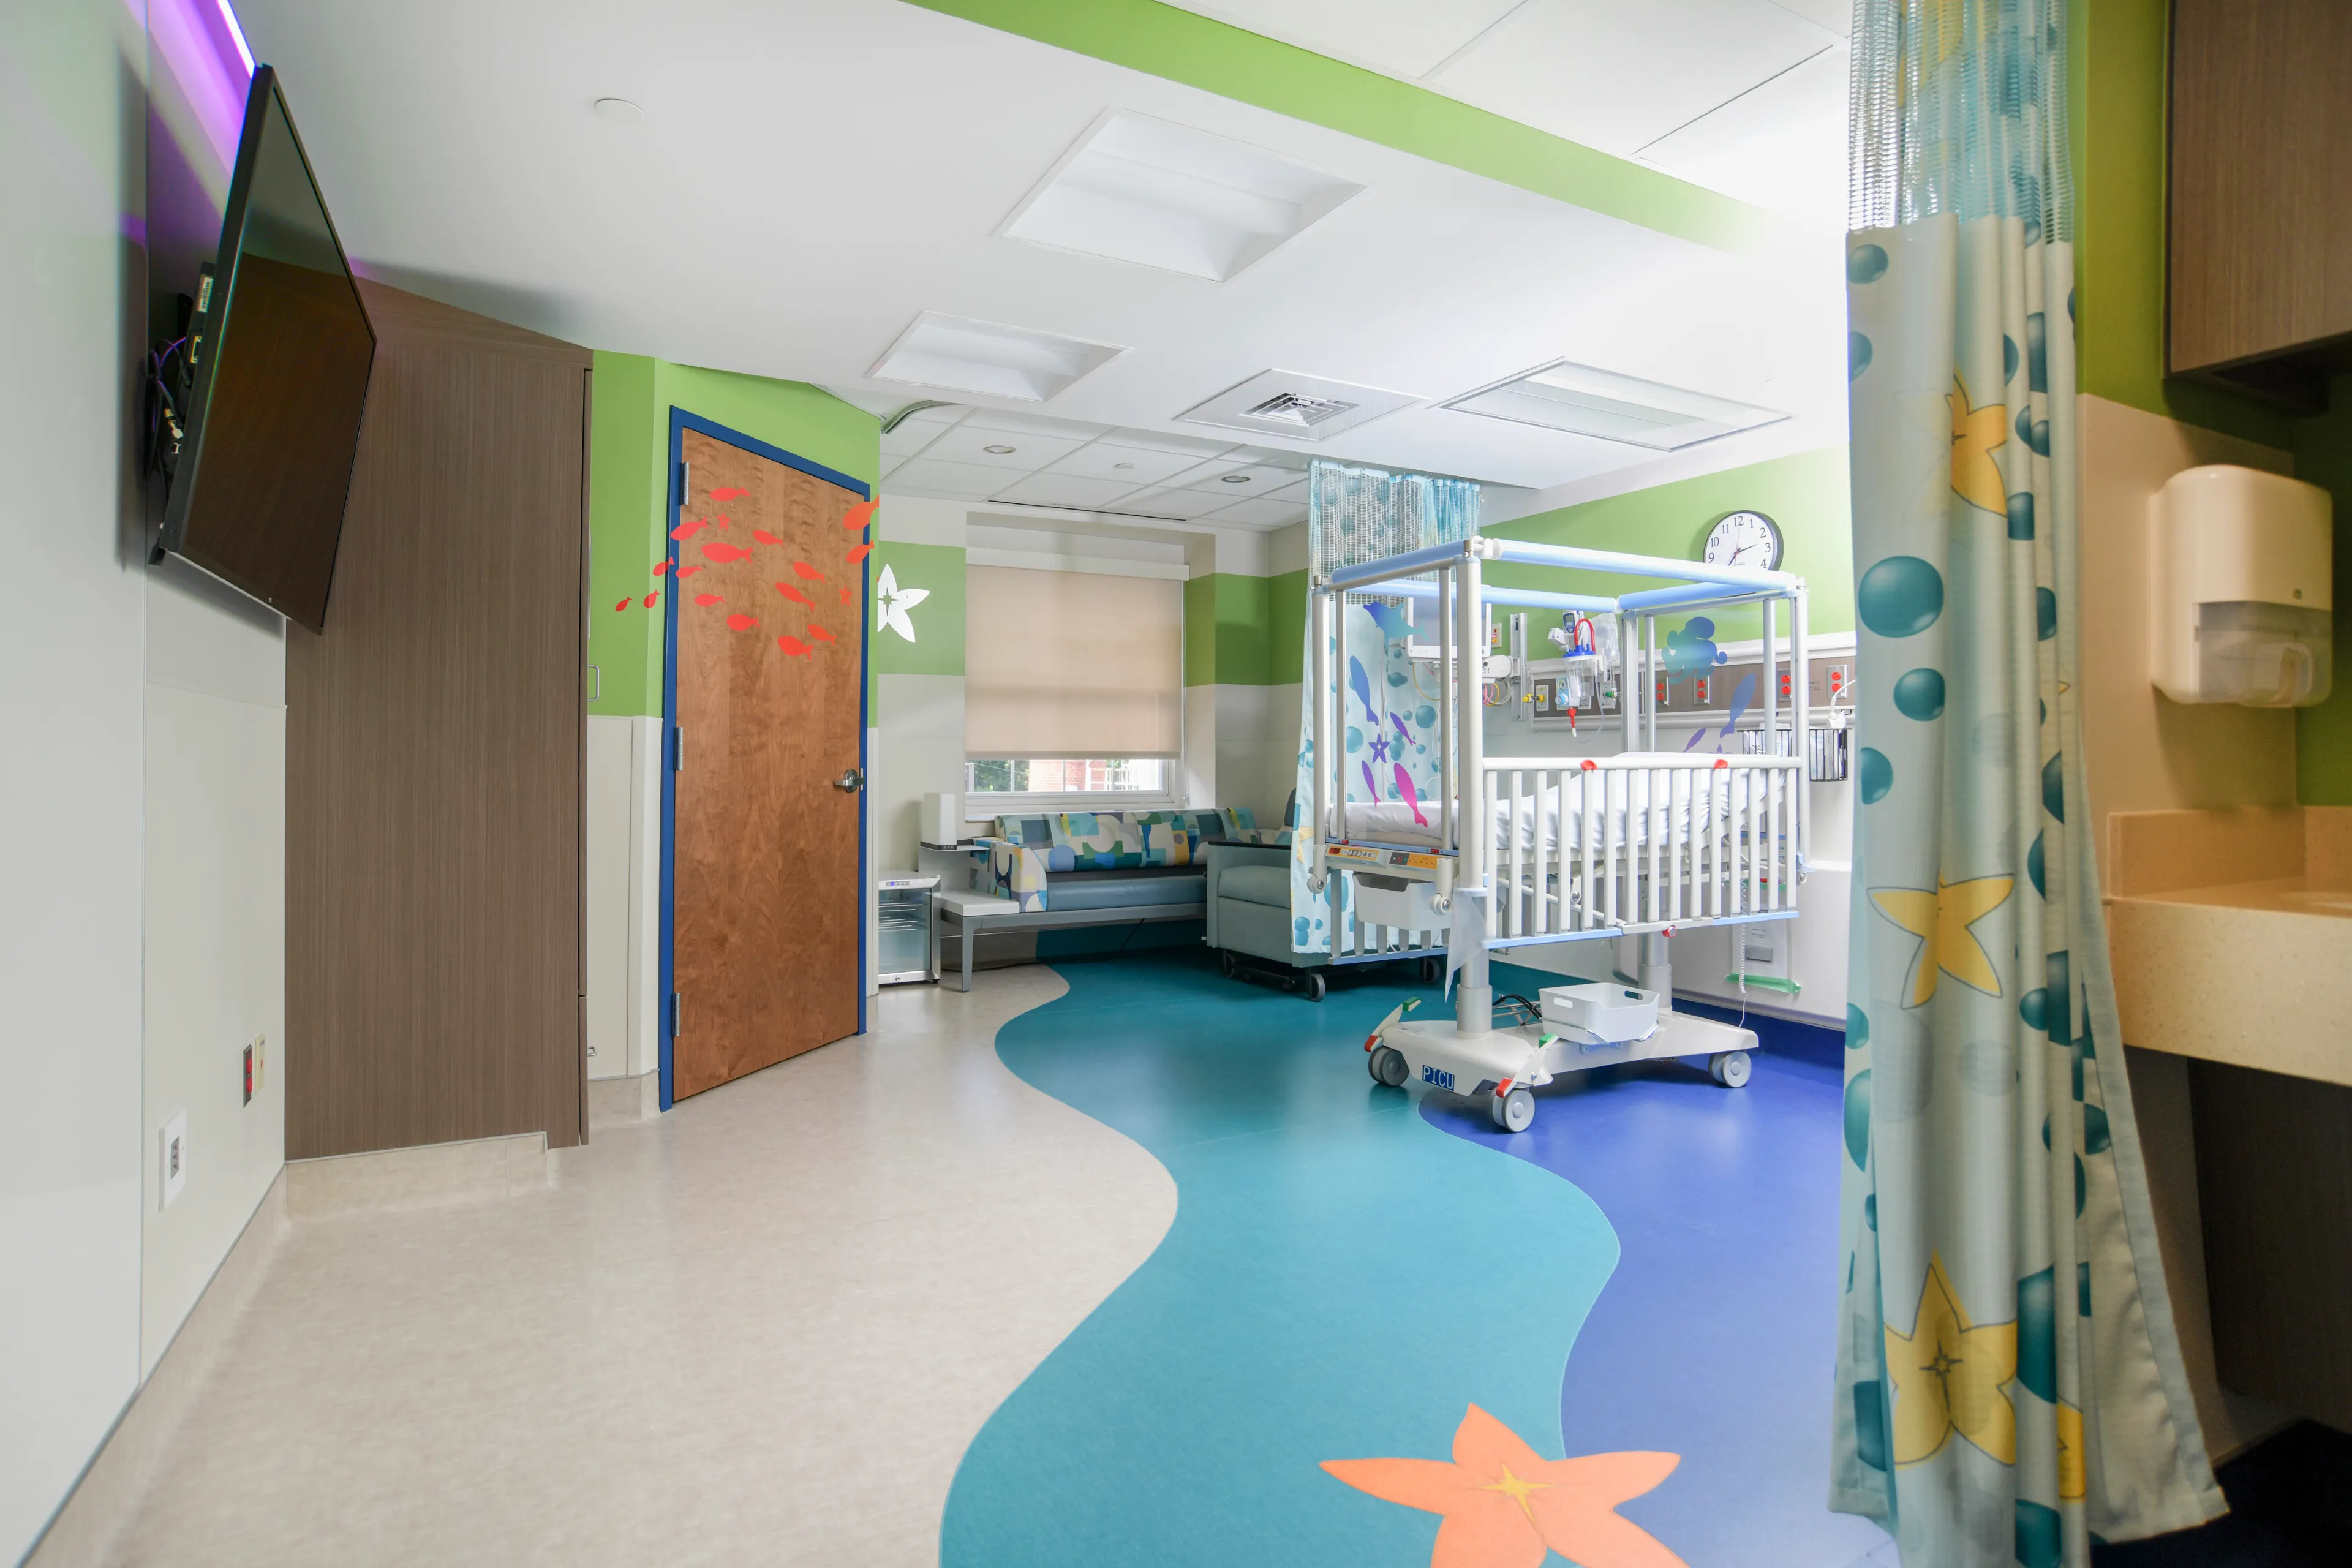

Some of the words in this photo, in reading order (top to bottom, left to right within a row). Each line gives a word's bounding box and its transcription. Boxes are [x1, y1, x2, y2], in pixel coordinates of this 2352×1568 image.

[1733, 516, 1744, 527] 12
[1750, 518, 1754, 529] 1
[1722, 524, 1729, 534] 11
[1760, 527, 1766, 538] 2
[1710, 537, 1719, 548] 10
[1765, 542, 1771, 552] 3
[1708, 552, 1714, 564] 9
[1760, 558, 1767, 568] 4
[1423, 1066, 1454, 1090] PICU
